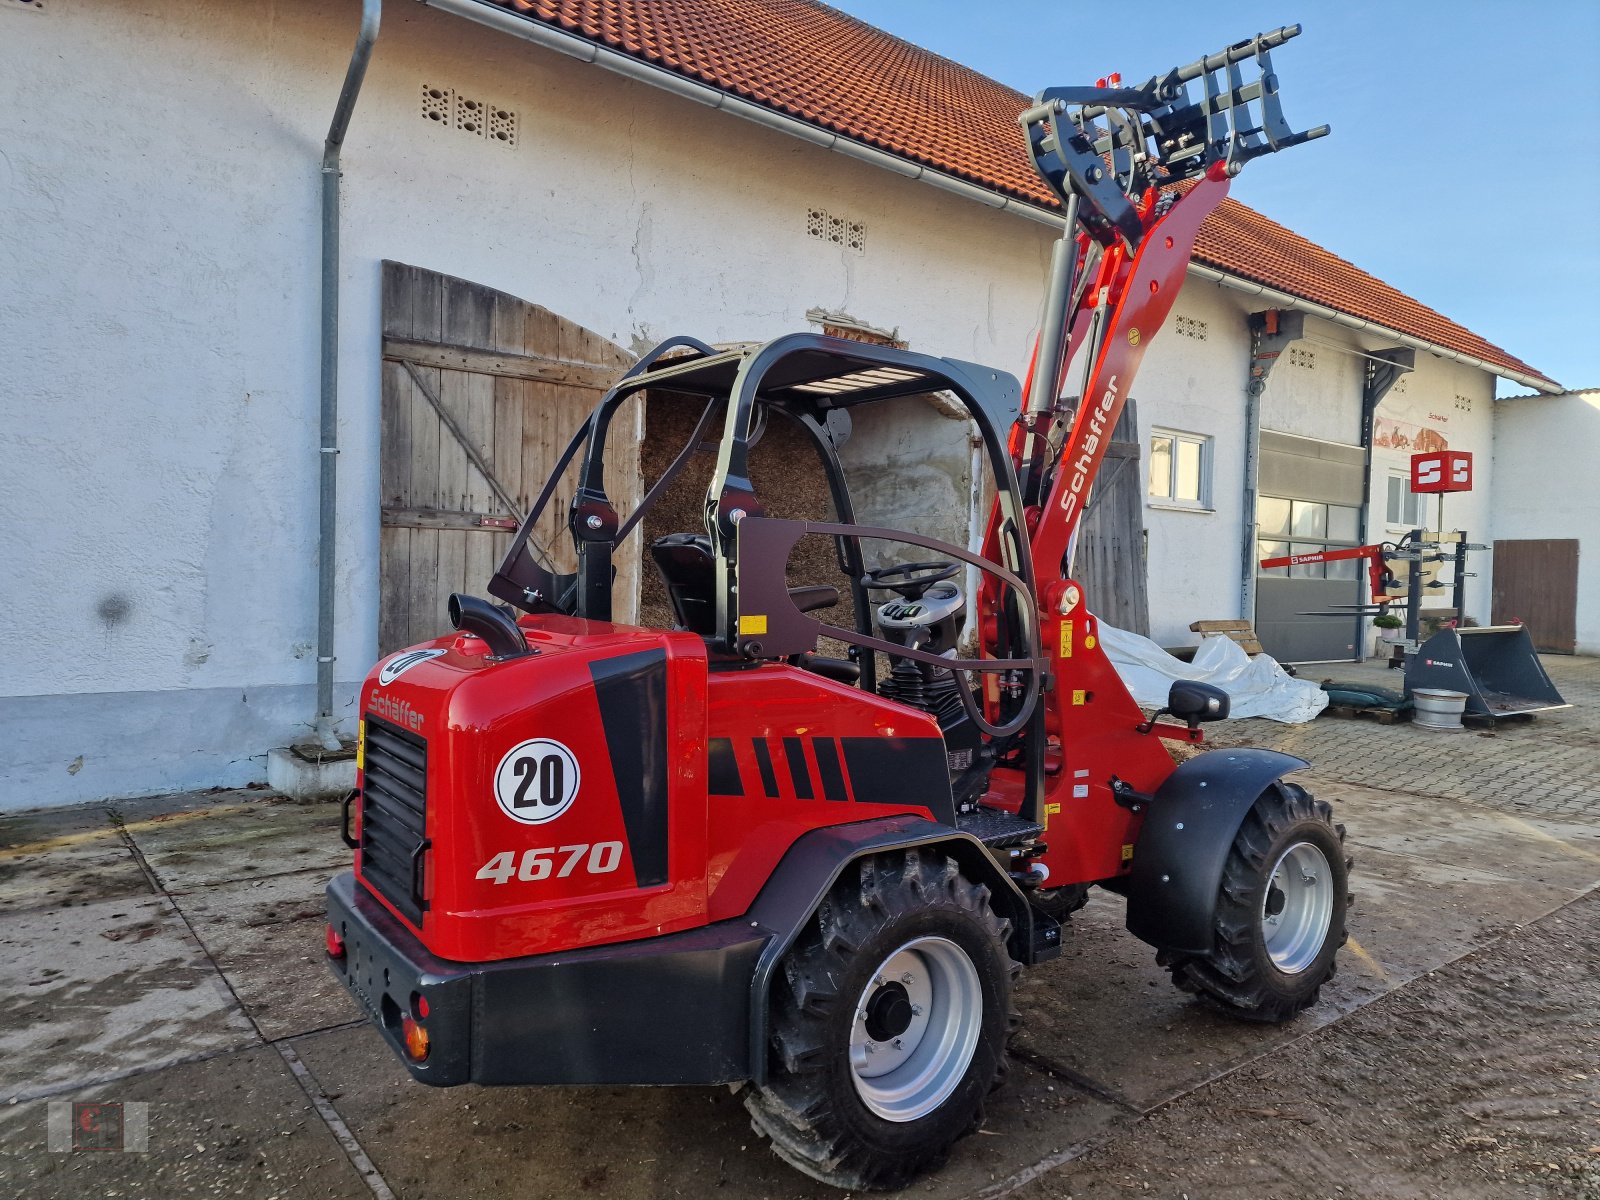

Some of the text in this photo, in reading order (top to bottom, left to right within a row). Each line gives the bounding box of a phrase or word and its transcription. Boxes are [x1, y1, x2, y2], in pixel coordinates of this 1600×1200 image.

[1060, 374, 1118, 523] Schäffer
[1299, 554, 1324, 563] SAPHIR
[367, 688, 425, 731] Schäffer
[513, 754, 564, 809] 20
[475, 840, 624, 885] 4670
